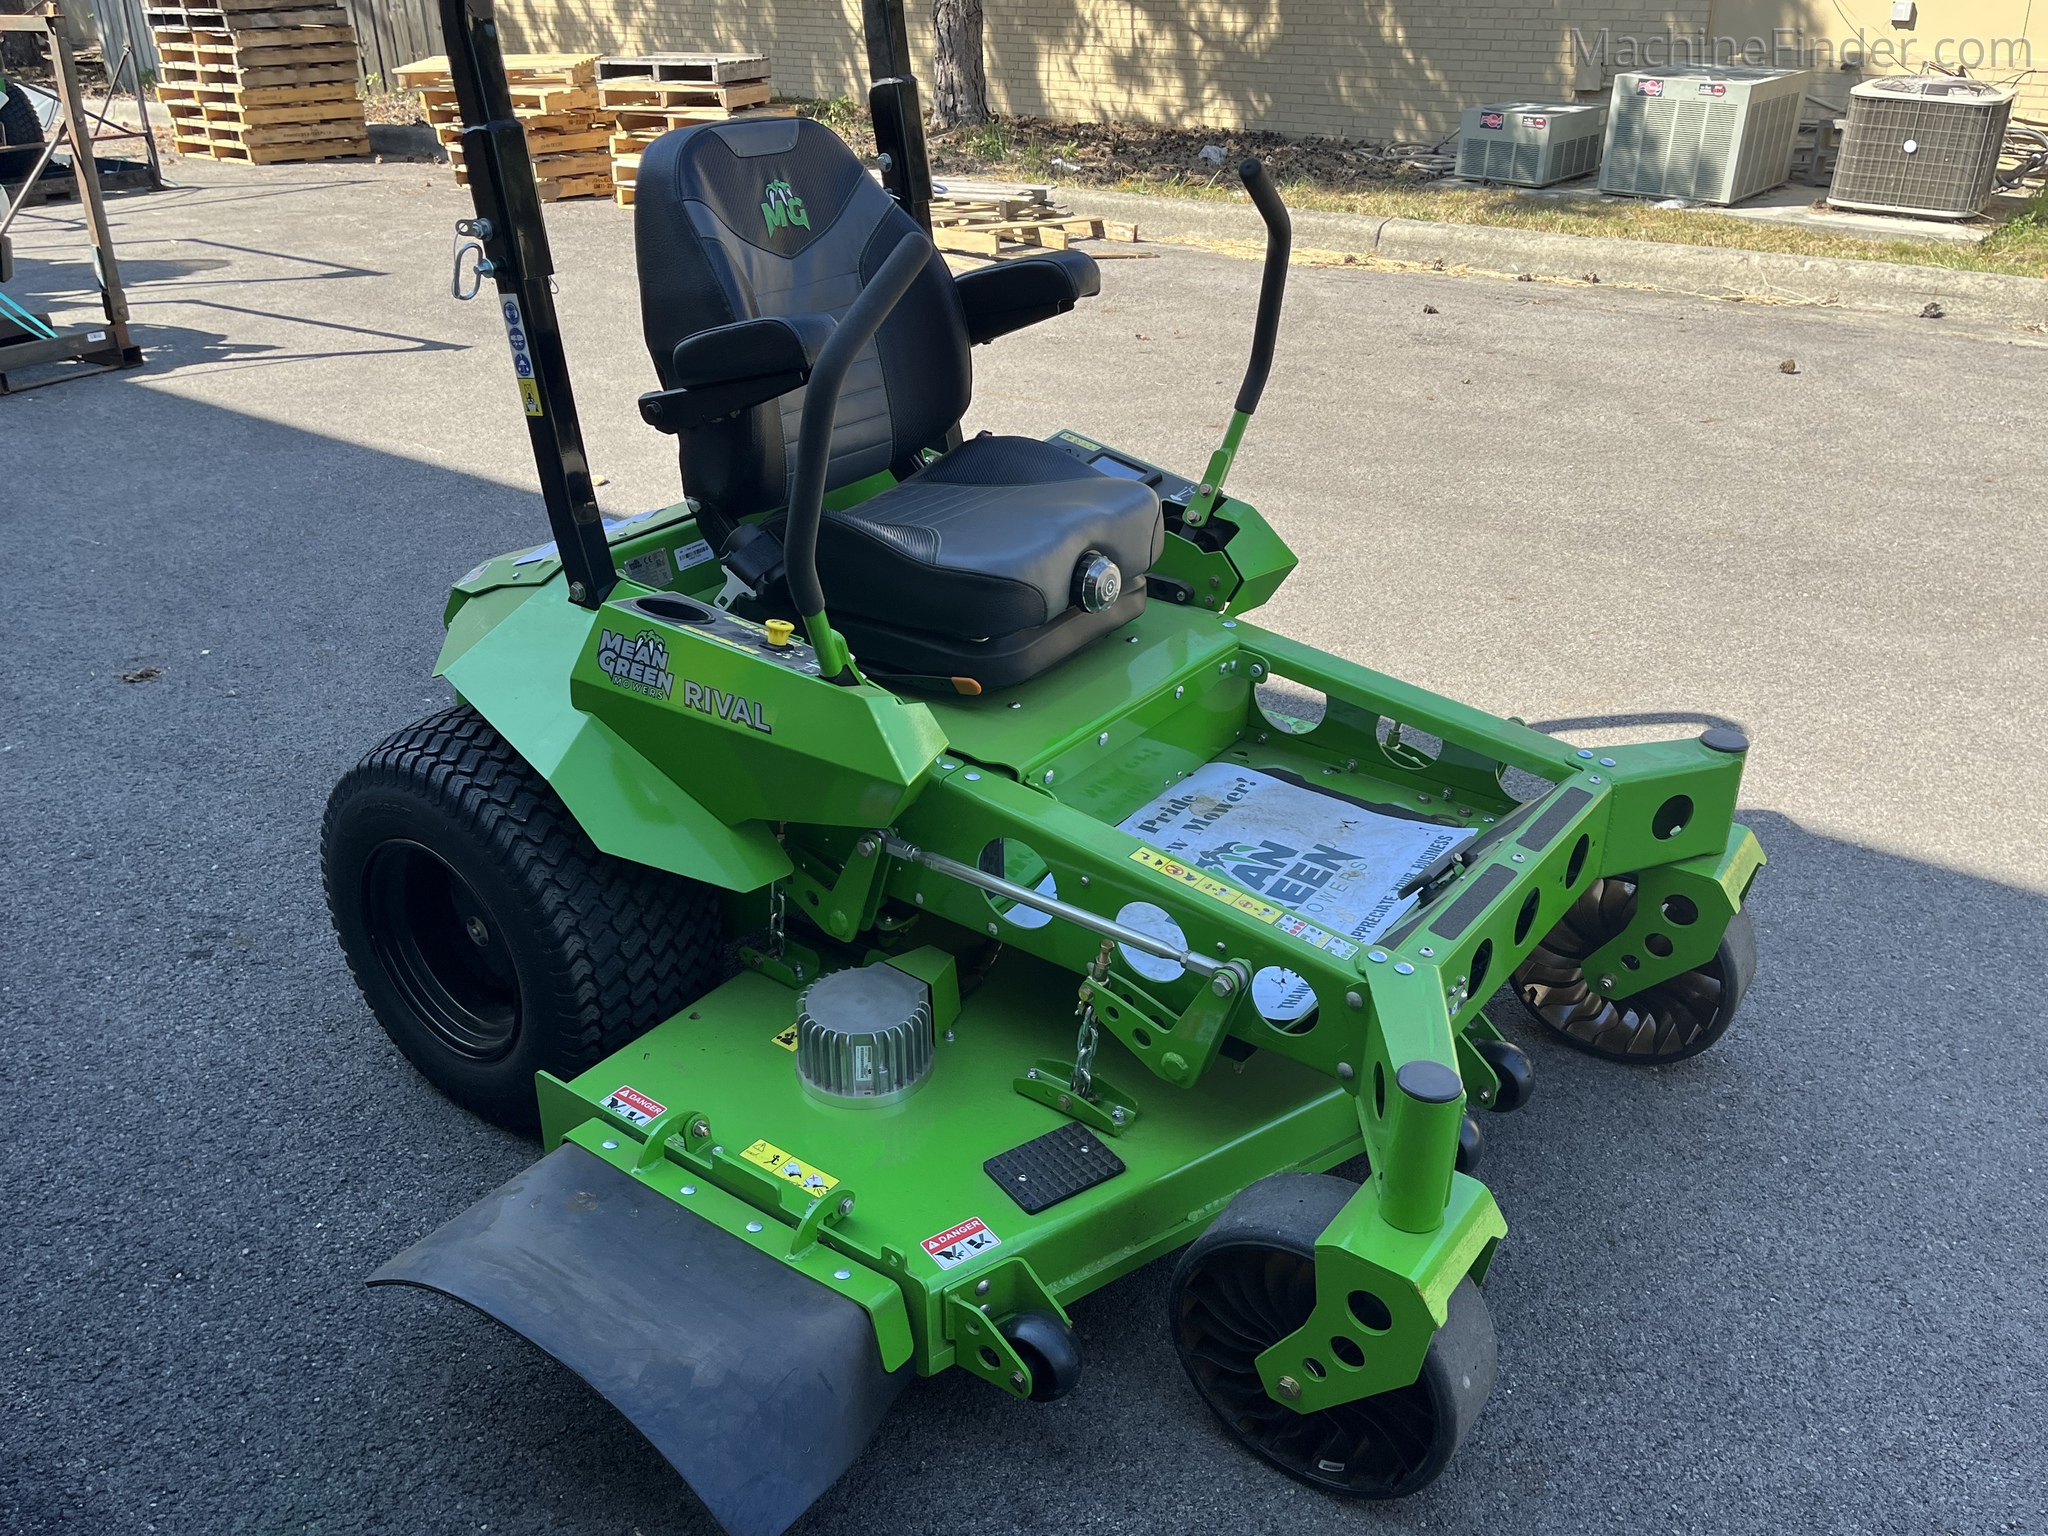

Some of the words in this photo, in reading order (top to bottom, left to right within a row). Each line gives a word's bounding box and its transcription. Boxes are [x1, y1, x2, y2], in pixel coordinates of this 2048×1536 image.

[761, 196, 810, 238] MG
[600, 629, 669, 670] MEAN
[598, 648, 674, 700] GREEN
[613, 676, 664, 700] MOWERS
[684, 680, 772, 735] RIVAL
[1138, 795, 1197, 834] Pride
[1181, 777, 1257, 835] Mower!
[1231, 840, 1299, 891] AN
[1412, 835, 1453, 869] BUSINESS
[1265, 843, 1366, 908] EEN
[1306, 861, 1368, 912] OWERS
[628, 1092, 662, 1115] DANGER
[938, 1220, 981, 1243] DANGER
